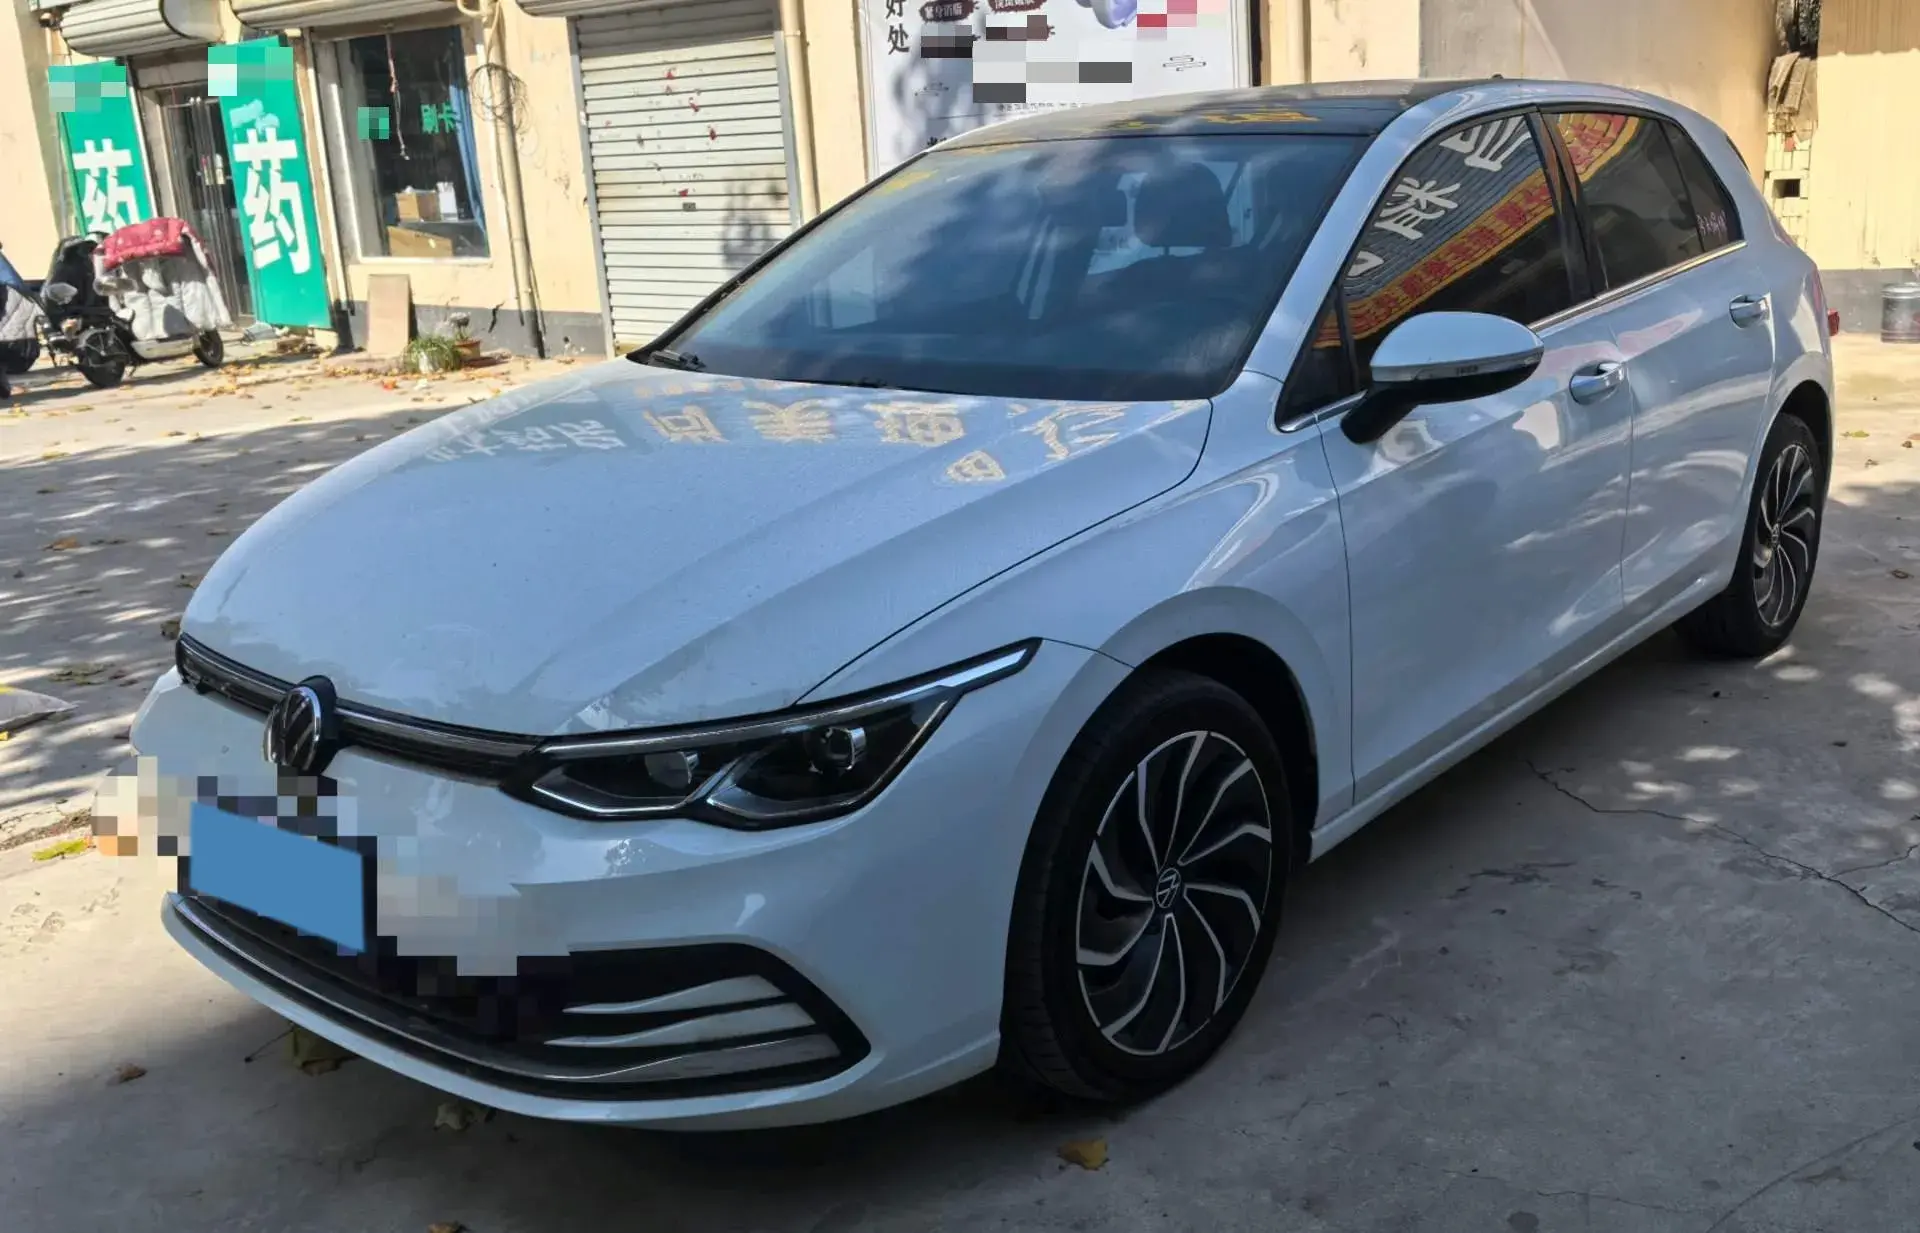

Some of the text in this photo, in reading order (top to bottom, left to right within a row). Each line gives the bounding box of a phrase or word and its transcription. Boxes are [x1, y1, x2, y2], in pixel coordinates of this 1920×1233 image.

[885, 0, 910, 55] 好处
[420, 102, 459, 134] 刷卡
[72, 138, 138, 234] 药
[233, 129, 311, 275] 药
